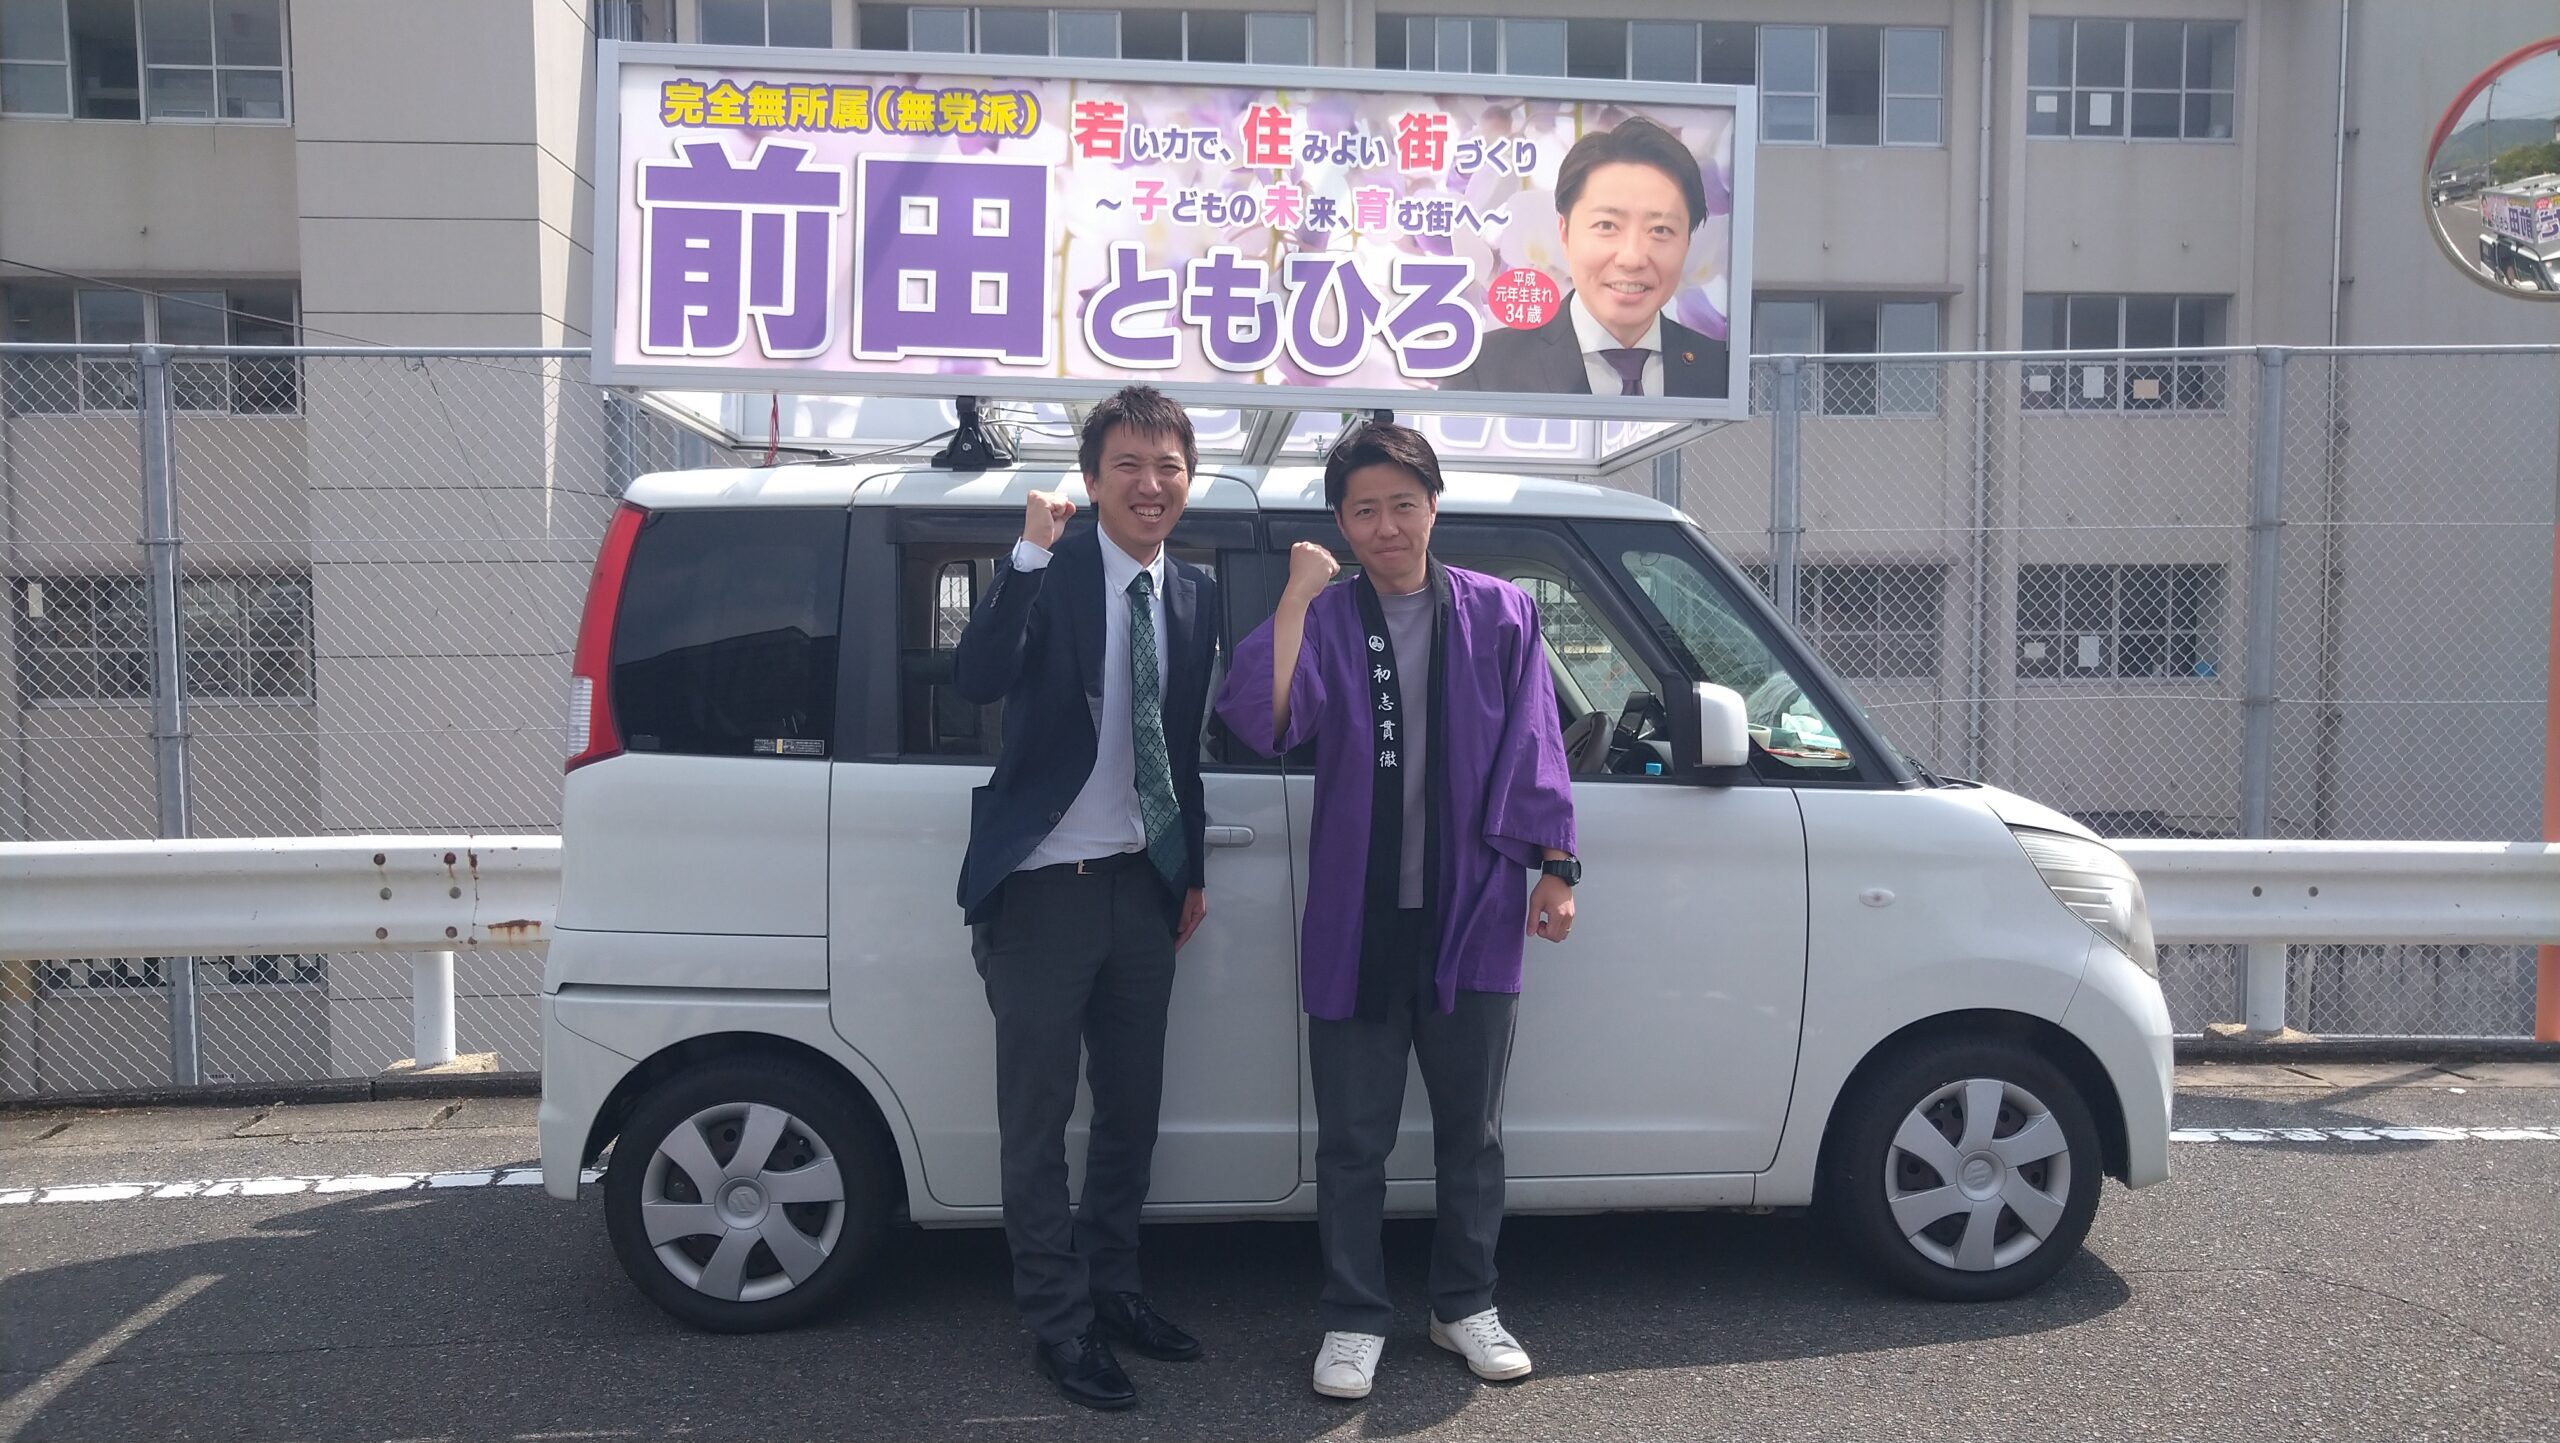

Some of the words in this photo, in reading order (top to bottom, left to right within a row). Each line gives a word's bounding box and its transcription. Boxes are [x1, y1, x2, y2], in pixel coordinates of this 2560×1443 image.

[662, 81, 1038, 135] 完全無所属(無党派)
[1073, 100, 1538, 175] 若い力で、住みよい街づくり
[642, 140, 1050, 358] 前田
[1087, 246, 1480, 374] ともひろ
[1513, 271, 1537, 287] 平成
[1495, 286, 1553, 304] 元年生まれ
[1505, 303, 1542, 324] 34歳
[1373, 664, 1397, 768] 初志貫徹
